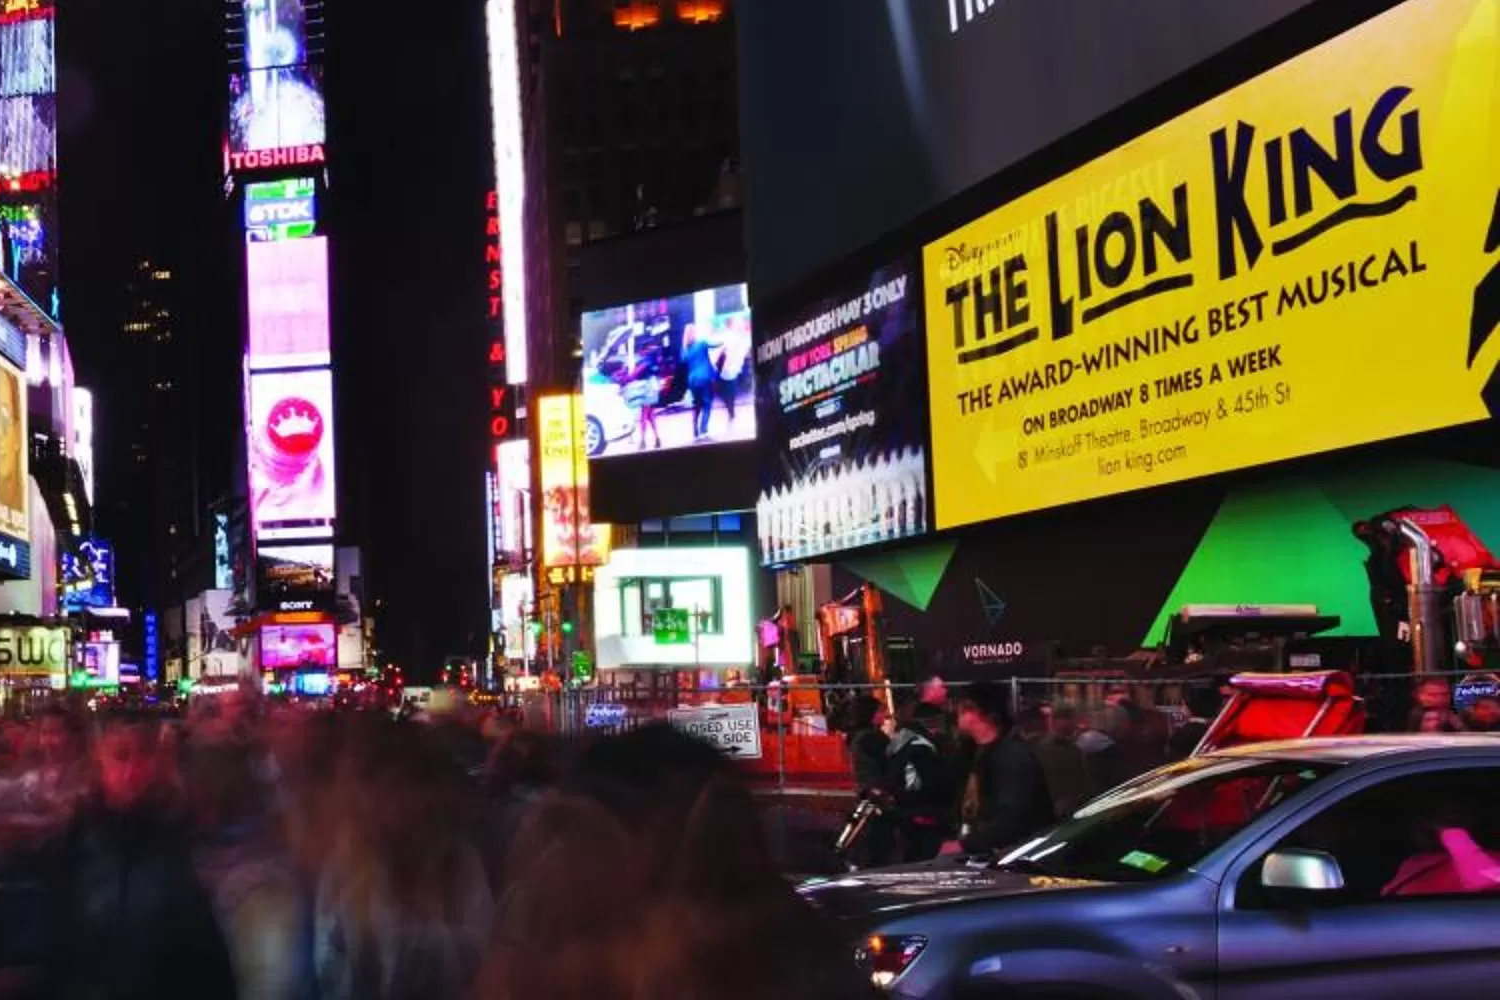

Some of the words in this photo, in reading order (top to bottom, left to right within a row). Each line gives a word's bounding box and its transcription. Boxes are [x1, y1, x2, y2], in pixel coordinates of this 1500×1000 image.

[231, 145, 325, 169] TOSHIBA
[266, 202, 310, 221] TDK
[946, 254, 1030, 349] THE
[1045, 182, 1192, 341] LION
[1210, 86, 1424, 281] KING
[486, 190, 502, 318] ERNST
[783, 311, 837, 351] THROUGH
[837, 296, 862, 328] MAY
[872, 275, 908, 309] ONLY
[957, 384, 993, 417] THE
[997, 315, 1200, 405] AWARD-WINNING
[1208, 291, 1269, 337] BEST
[1276, 239, 1428, 316] MUSICAL
[489, 344, 504, 362] &
[779, 341, 880, 405] SPECTACULAR
[1023, 413, 1046, 437] ON
[1049, 387, 1134, 429] BROADWAY
[1138, 383, 1150, 404] 8
[1153, 367, 1204, 399] TIMES
[1209, 362, 1223, 385] A
[1227, 344, 1283, 379] WEEK
[1139, 403, 1212, 441] Broadway
[1215, 396, 1229, 420] &
[1233, 389, 1269, 416] 45th
[1275, 381, 1292, 406] St
[963, 641, 1023, 659] VORNADO
[722, 732, 753, 745] SIDE
[727, 720, 753, 732] USE
